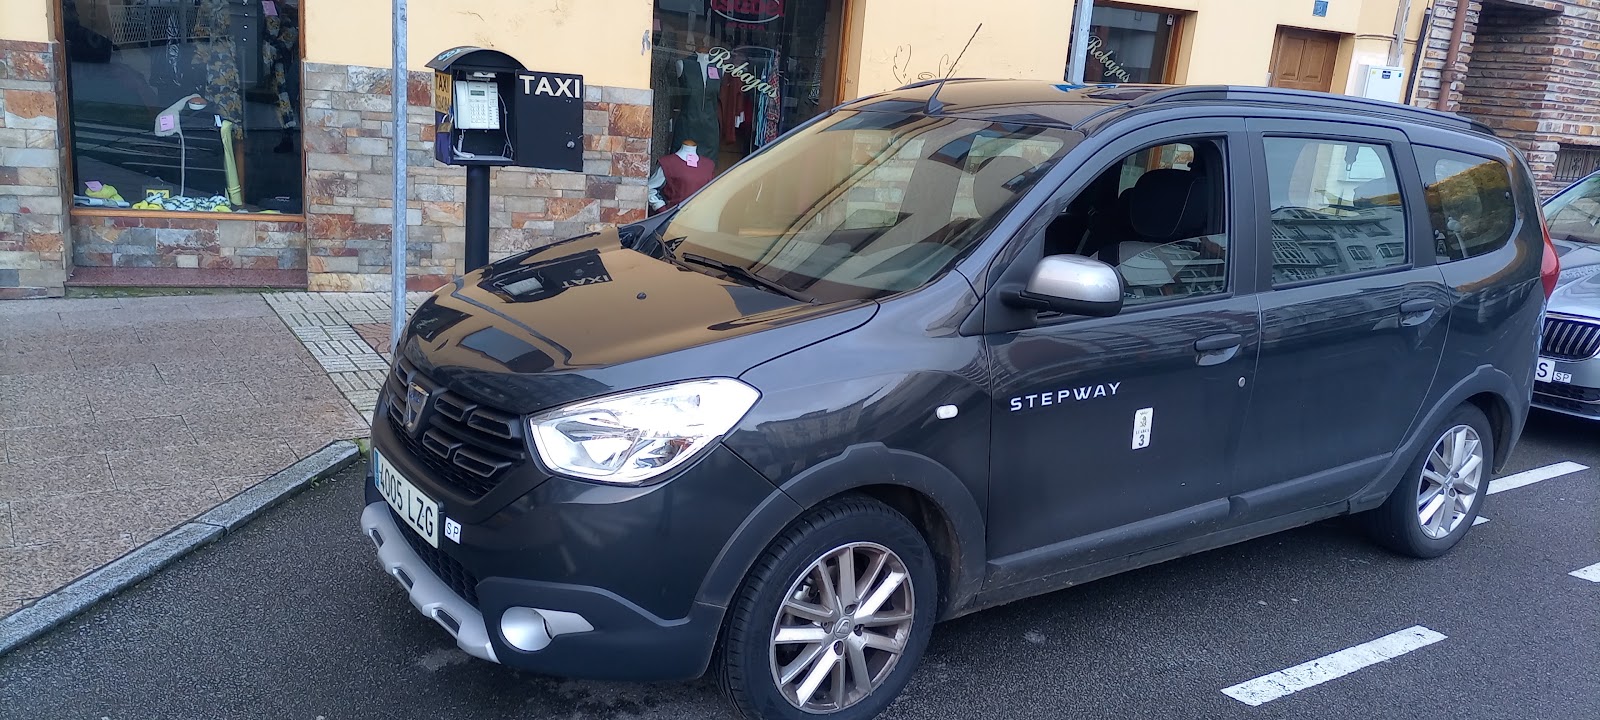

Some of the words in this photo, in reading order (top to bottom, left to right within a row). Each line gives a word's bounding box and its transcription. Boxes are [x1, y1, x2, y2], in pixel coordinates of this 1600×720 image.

[1087, 35, 1130, 83] Rebajas
[434, 73, 449, 93] TAXI
[708, 46, 777, 98] Rebajas
[519, 75, 580, 98] TAXI
[1555, 372, 1569, 381] SP
[1010, 381, 1121, 411] STEPWAY
[1138, 434, 1145, 446] 3
[380, 463, 403, 510] 4005
[408, 489, 433, 537] LZG
[446, 522, 459, 537] SP
